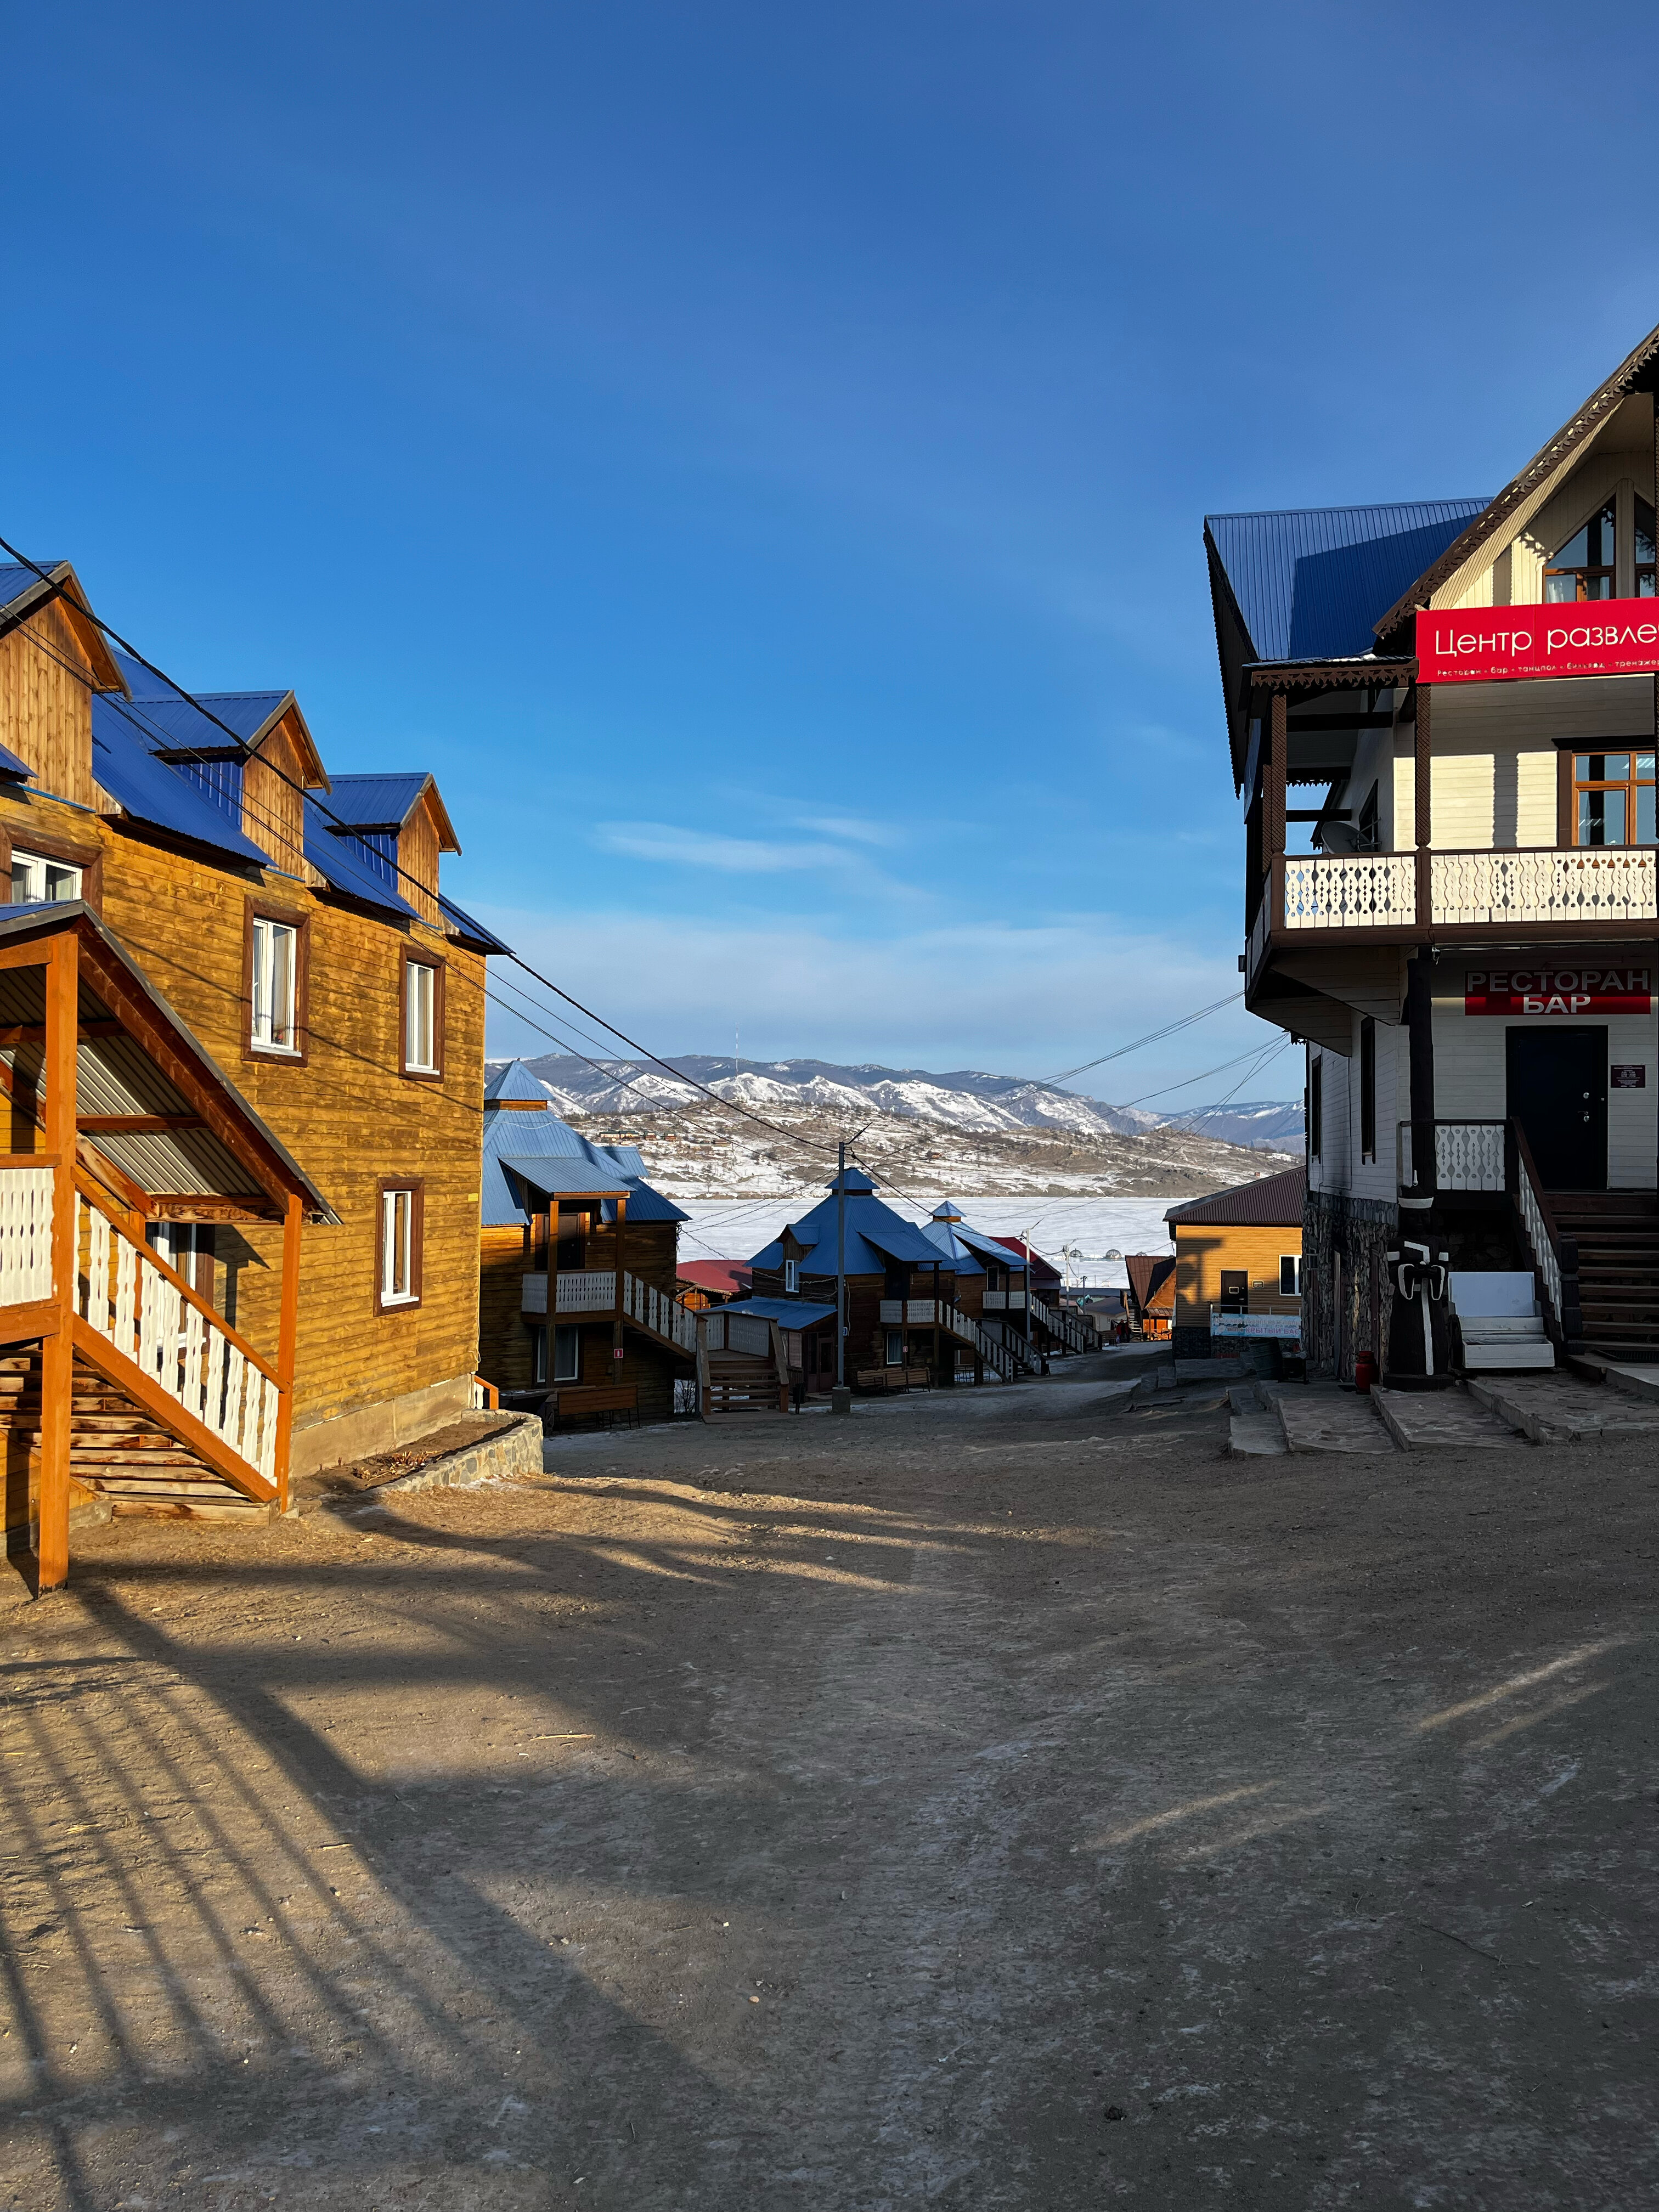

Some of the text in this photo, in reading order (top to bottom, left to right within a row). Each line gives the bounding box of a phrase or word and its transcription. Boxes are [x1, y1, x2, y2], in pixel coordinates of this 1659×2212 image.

[1436, 623, 1659, 657] Центр развле
[1491, 667, 1509, 675] бар
[1467, 970, 1648, 992] РЕСТОРАН
[1523, 994, 1591, 1014] БАР
